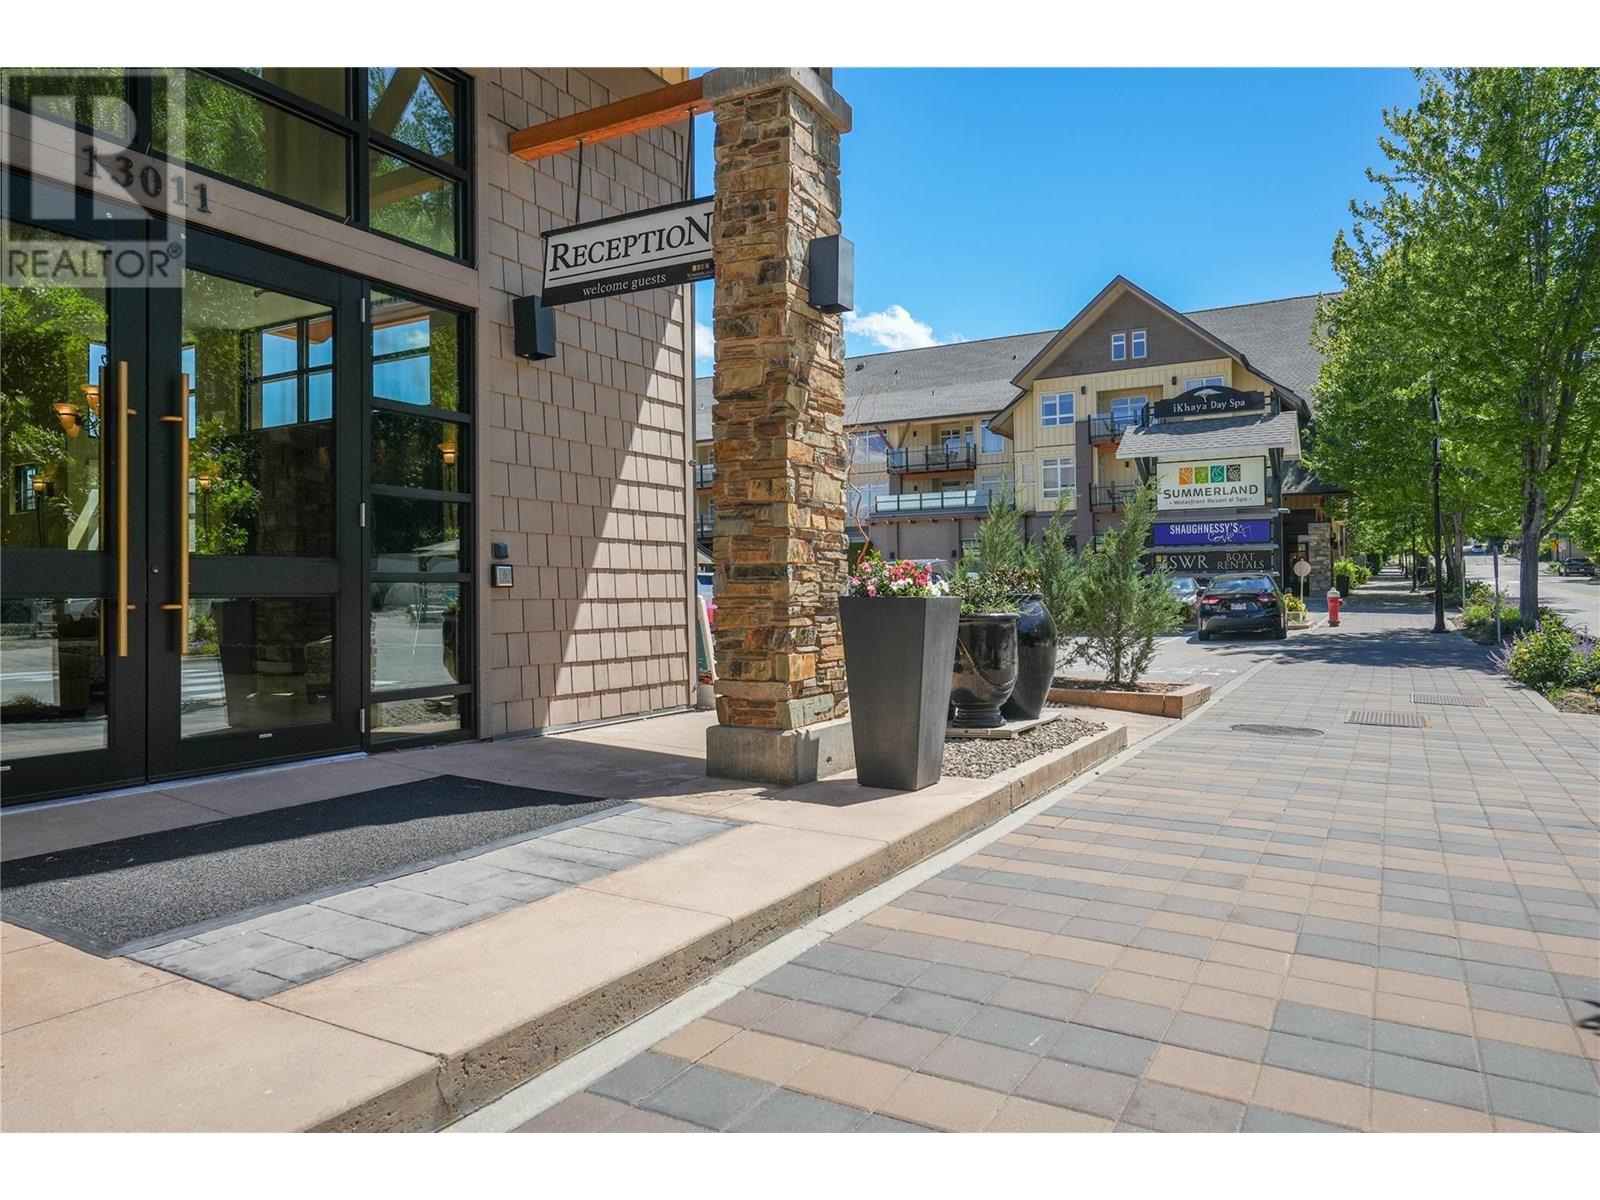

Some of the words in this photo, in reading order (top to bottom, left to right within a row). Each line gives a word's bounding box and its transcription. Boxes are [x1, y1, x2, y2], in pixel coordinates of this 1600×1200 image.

[82, 145, 212, 214] 13011
[582, 279, 629, 296] welcome
[631, 273, 667, 290] guests
[1173, 402, 1207, 415] iKhaya
[1210, 400, 1227, 410] Day
[1229, 398, 1246, 409] Spa
[1163, 484, 1258, 500] SUMMERLAND
[1169, 522, 1239, 535] SHAUGHNESSY'S
[1207, 532, 1235, 543] Cove
[1168, 554, 1209, 569] SWR
[1226, 552, 1256, 561] BOAT
[1217, 560, 1265, 570] RENTALS
